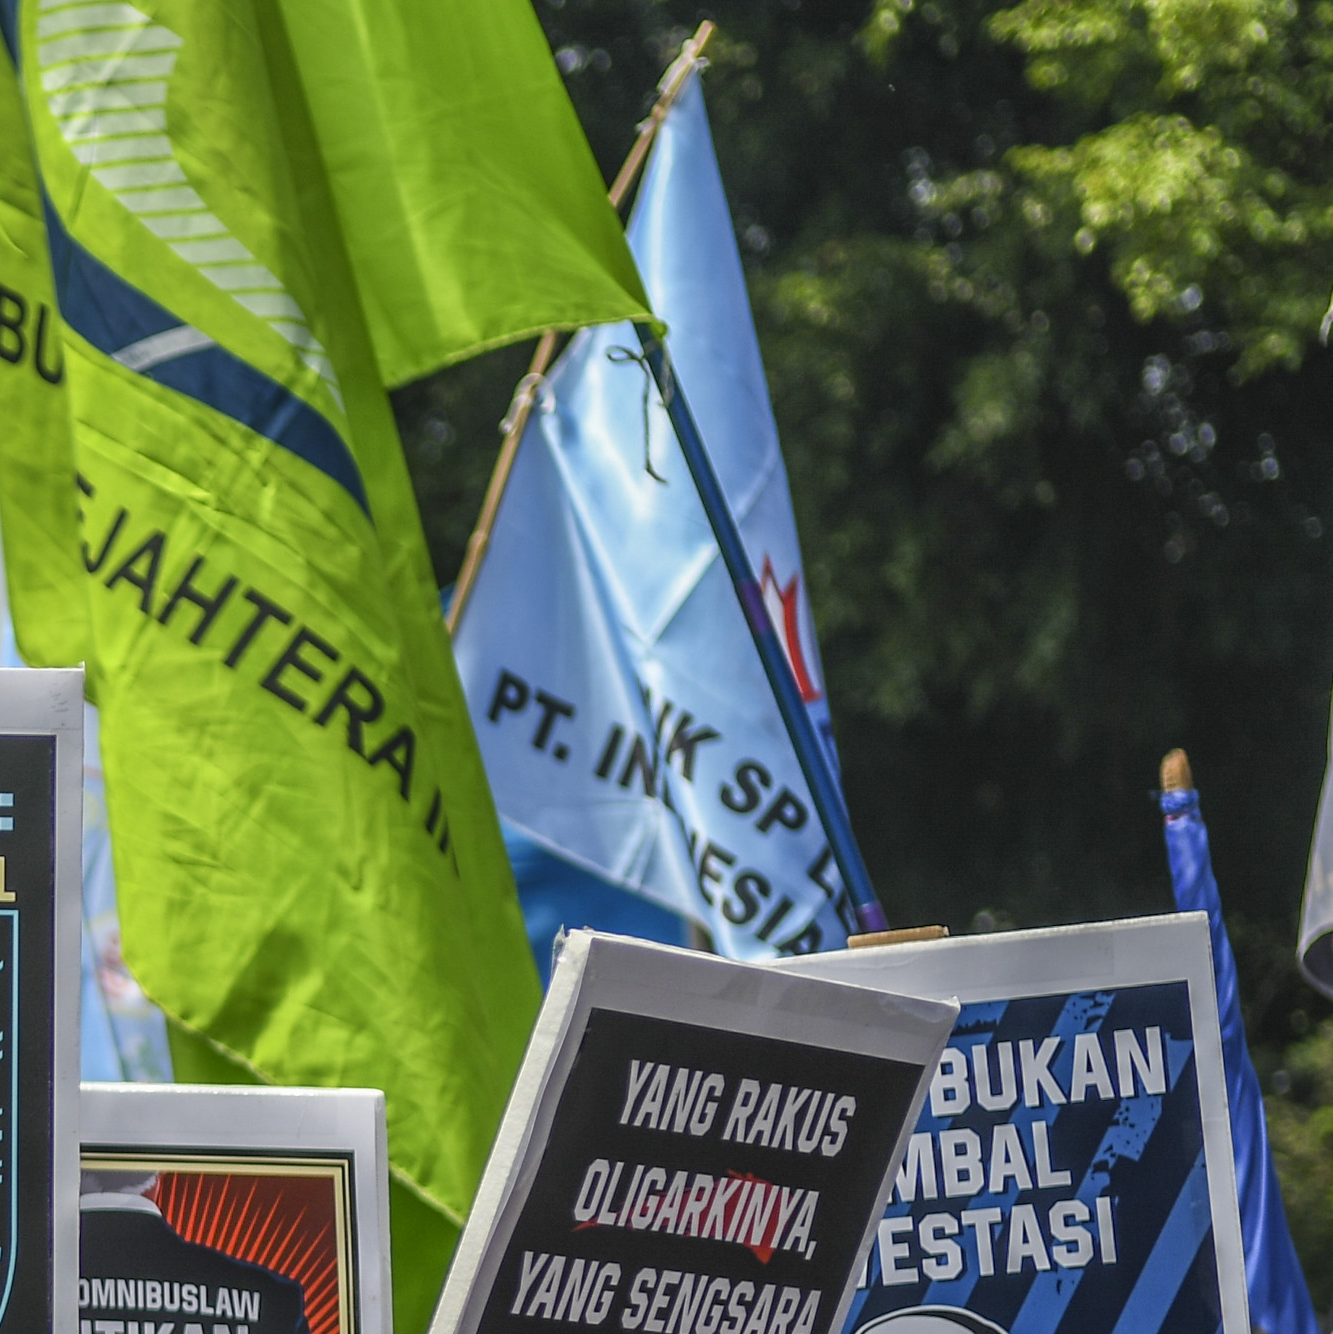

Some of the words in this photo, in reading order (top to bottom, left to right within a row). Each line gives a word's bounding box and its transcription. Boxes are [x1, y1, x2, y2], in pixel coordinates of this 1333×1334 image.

[487, 668, 576, 763] PT.
[620, 1058, 726, 1137] YANG
[723, 1079, 857, 1156] RAKUS
[929, 1026, 1167, 1118] BUKAN
[574, 1158, 820, 1259] OLIGARKINYA,
[887, 1120, 1072, 1203] MBAL
[511, 1252, 621, 1323] YANG
[857, 1196, 1117, 1290] ESTASI
